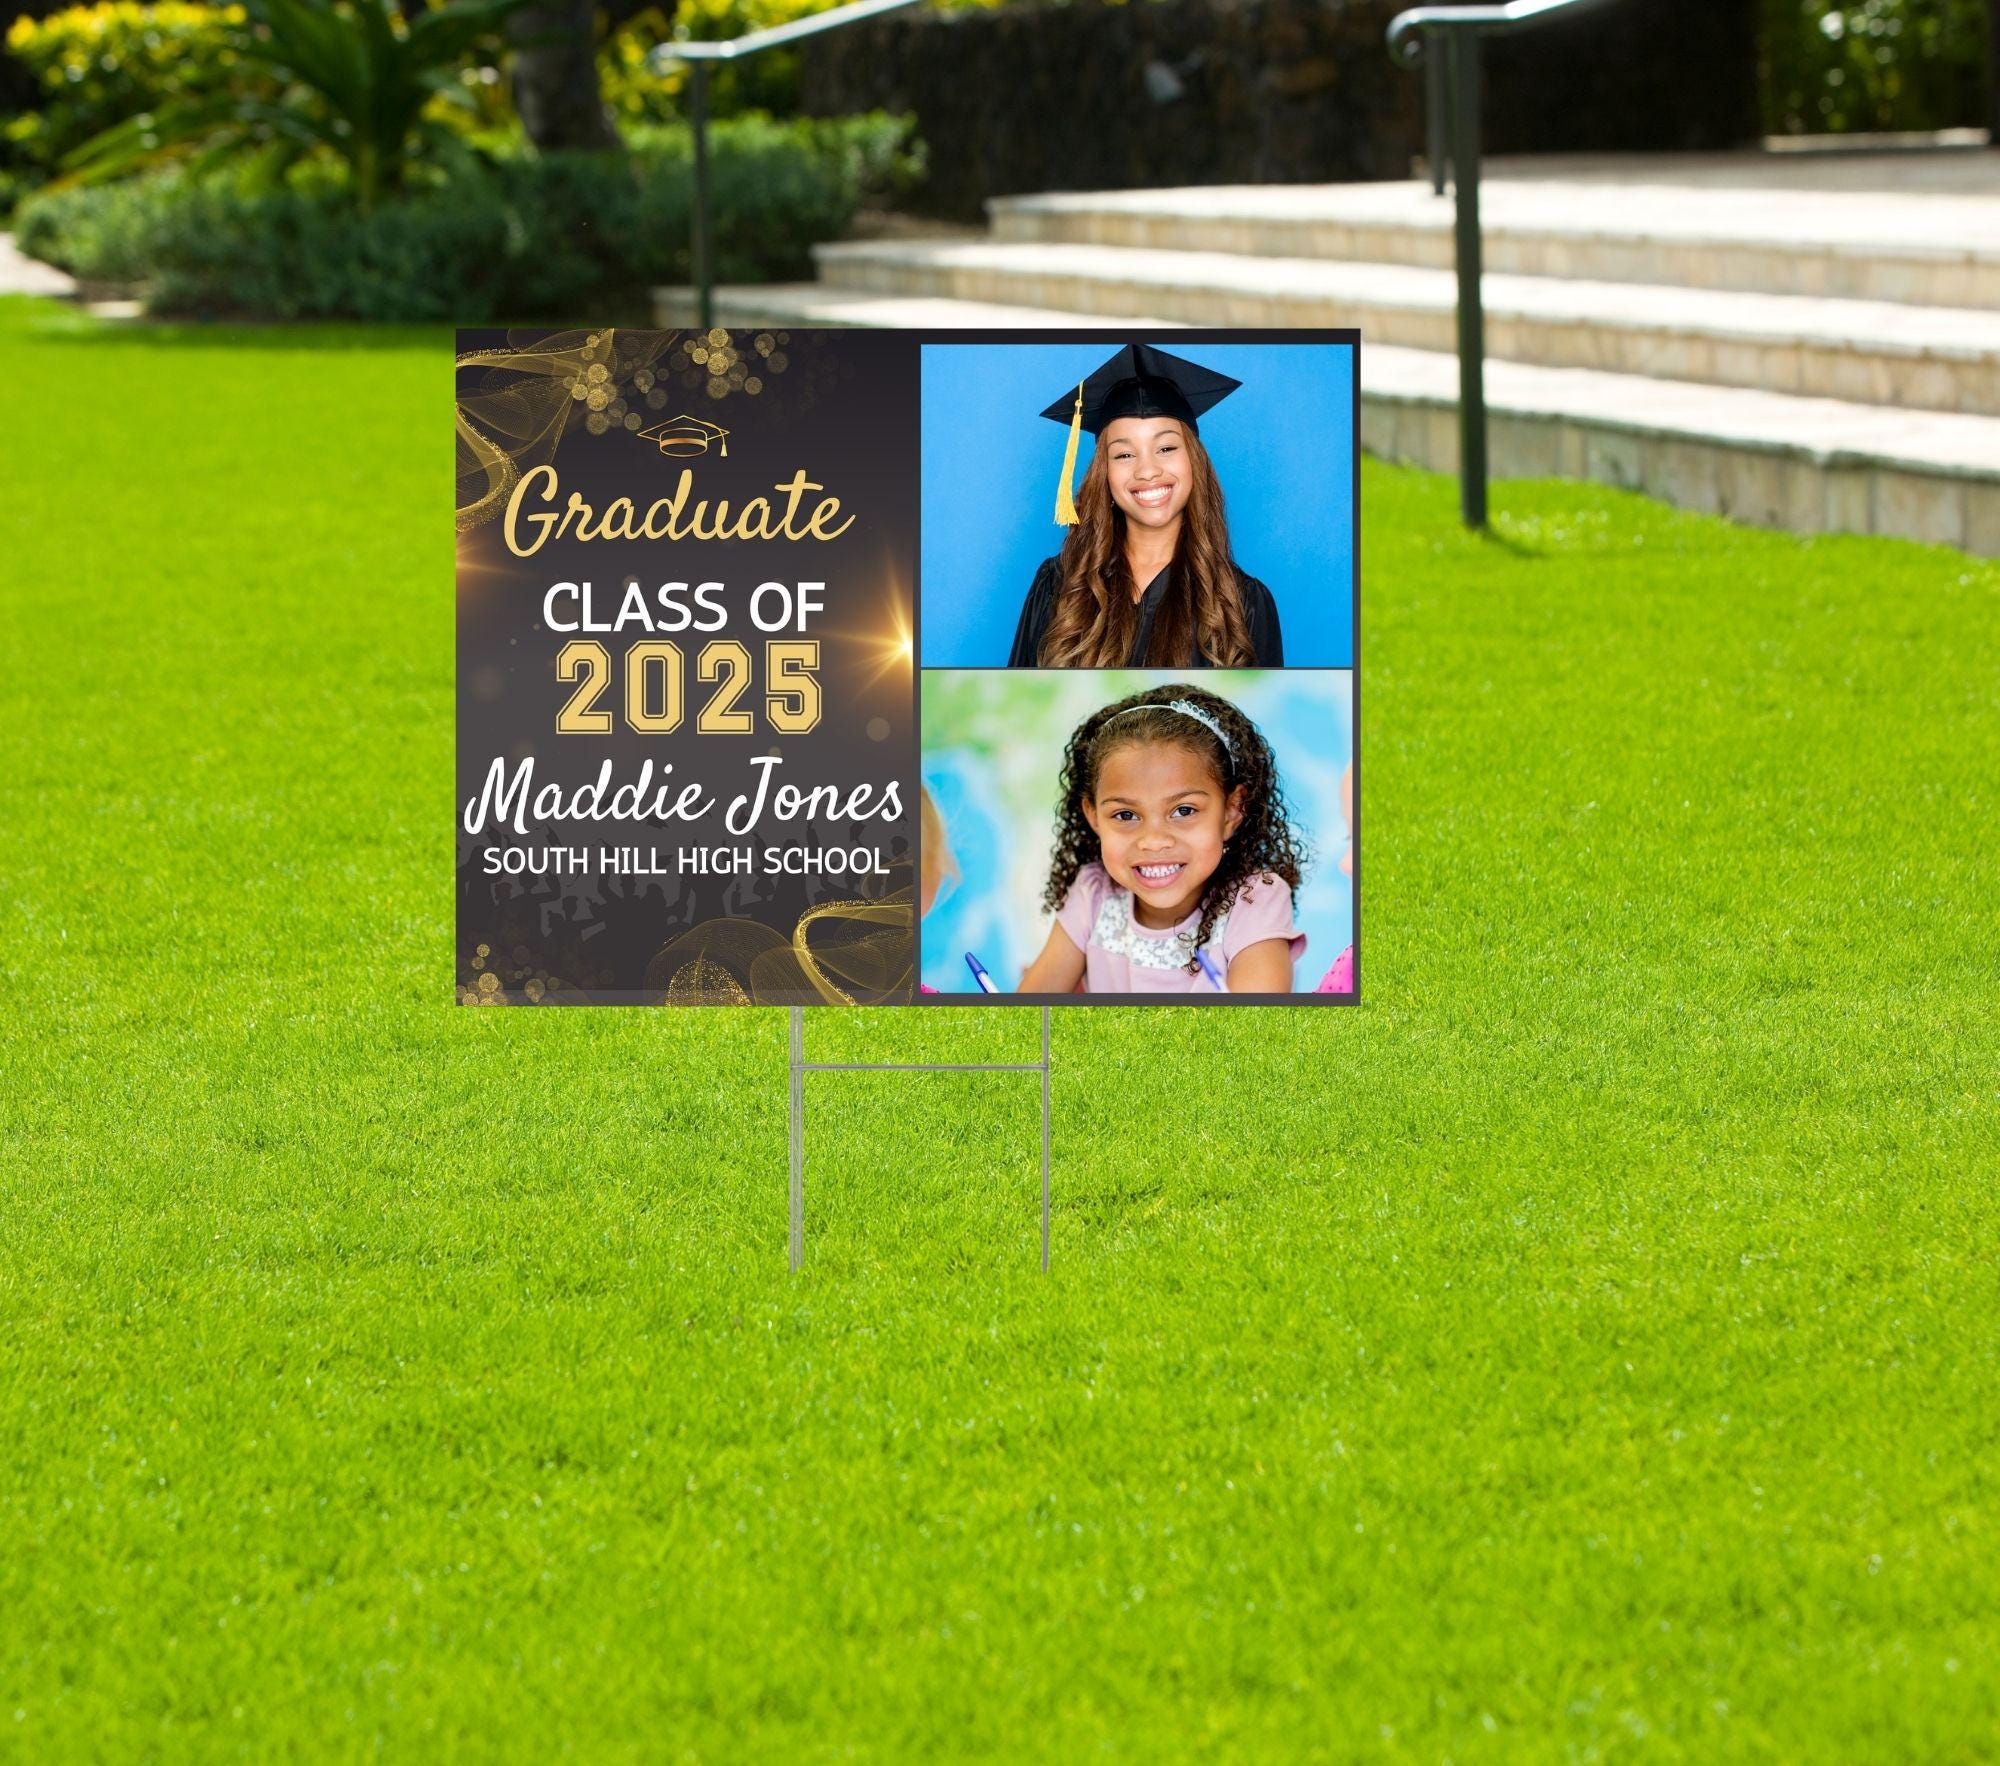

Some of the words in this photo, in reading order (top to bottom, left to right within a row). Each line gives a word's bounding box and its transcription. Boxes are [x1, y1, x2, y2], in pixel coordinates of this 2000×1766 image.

[504, 465, 856, 557] Graduate
[544, 582, 727, 632] CLASS
[750, 582, 825, 632] OF
[556, 640, 821, 734] 2025
[464, 757, 715, 834] Maddie
[725, 756, 903, 835] Jones
[483, 847, 587, 874] SOUTH
[601, 847, 667, 874] HILL
[679, 847, 751, 874] HIGH
[764, 847, 890, 874] SCHOOL
